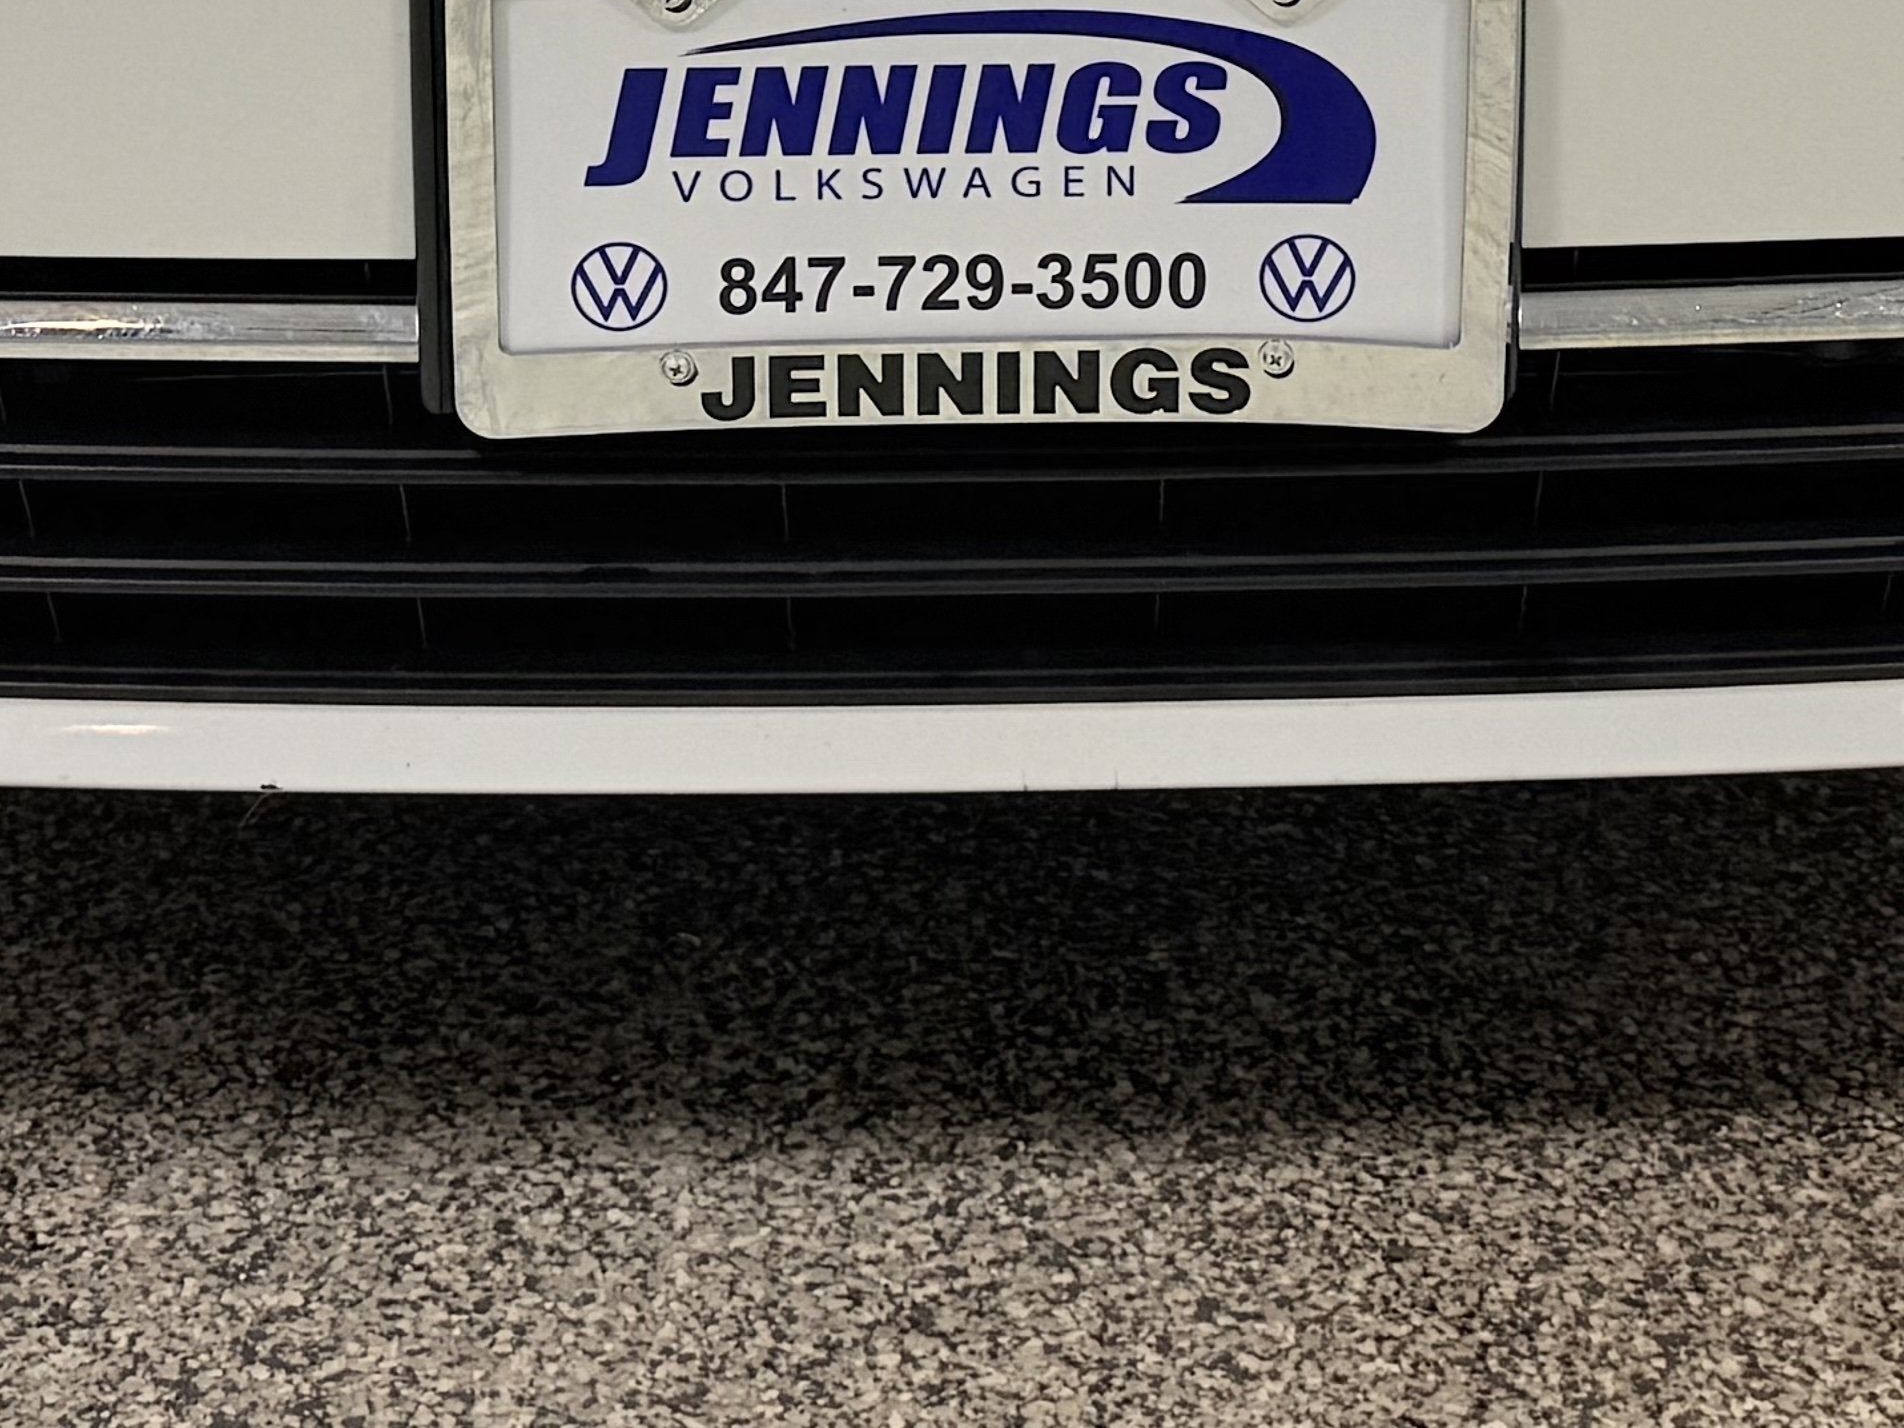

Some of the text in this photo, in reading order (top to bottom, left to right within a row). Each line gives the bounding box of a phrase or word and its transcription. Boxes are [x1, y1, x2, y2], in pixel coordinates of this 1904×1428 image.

[584, 61, 1228, 188] JENNINGS
[673, 165, 1134, 203] VOLKSWAGEN
[719, 252, 1207, 316] 847-729-3500
[701, 347, 1251, 422] JENNINGS
